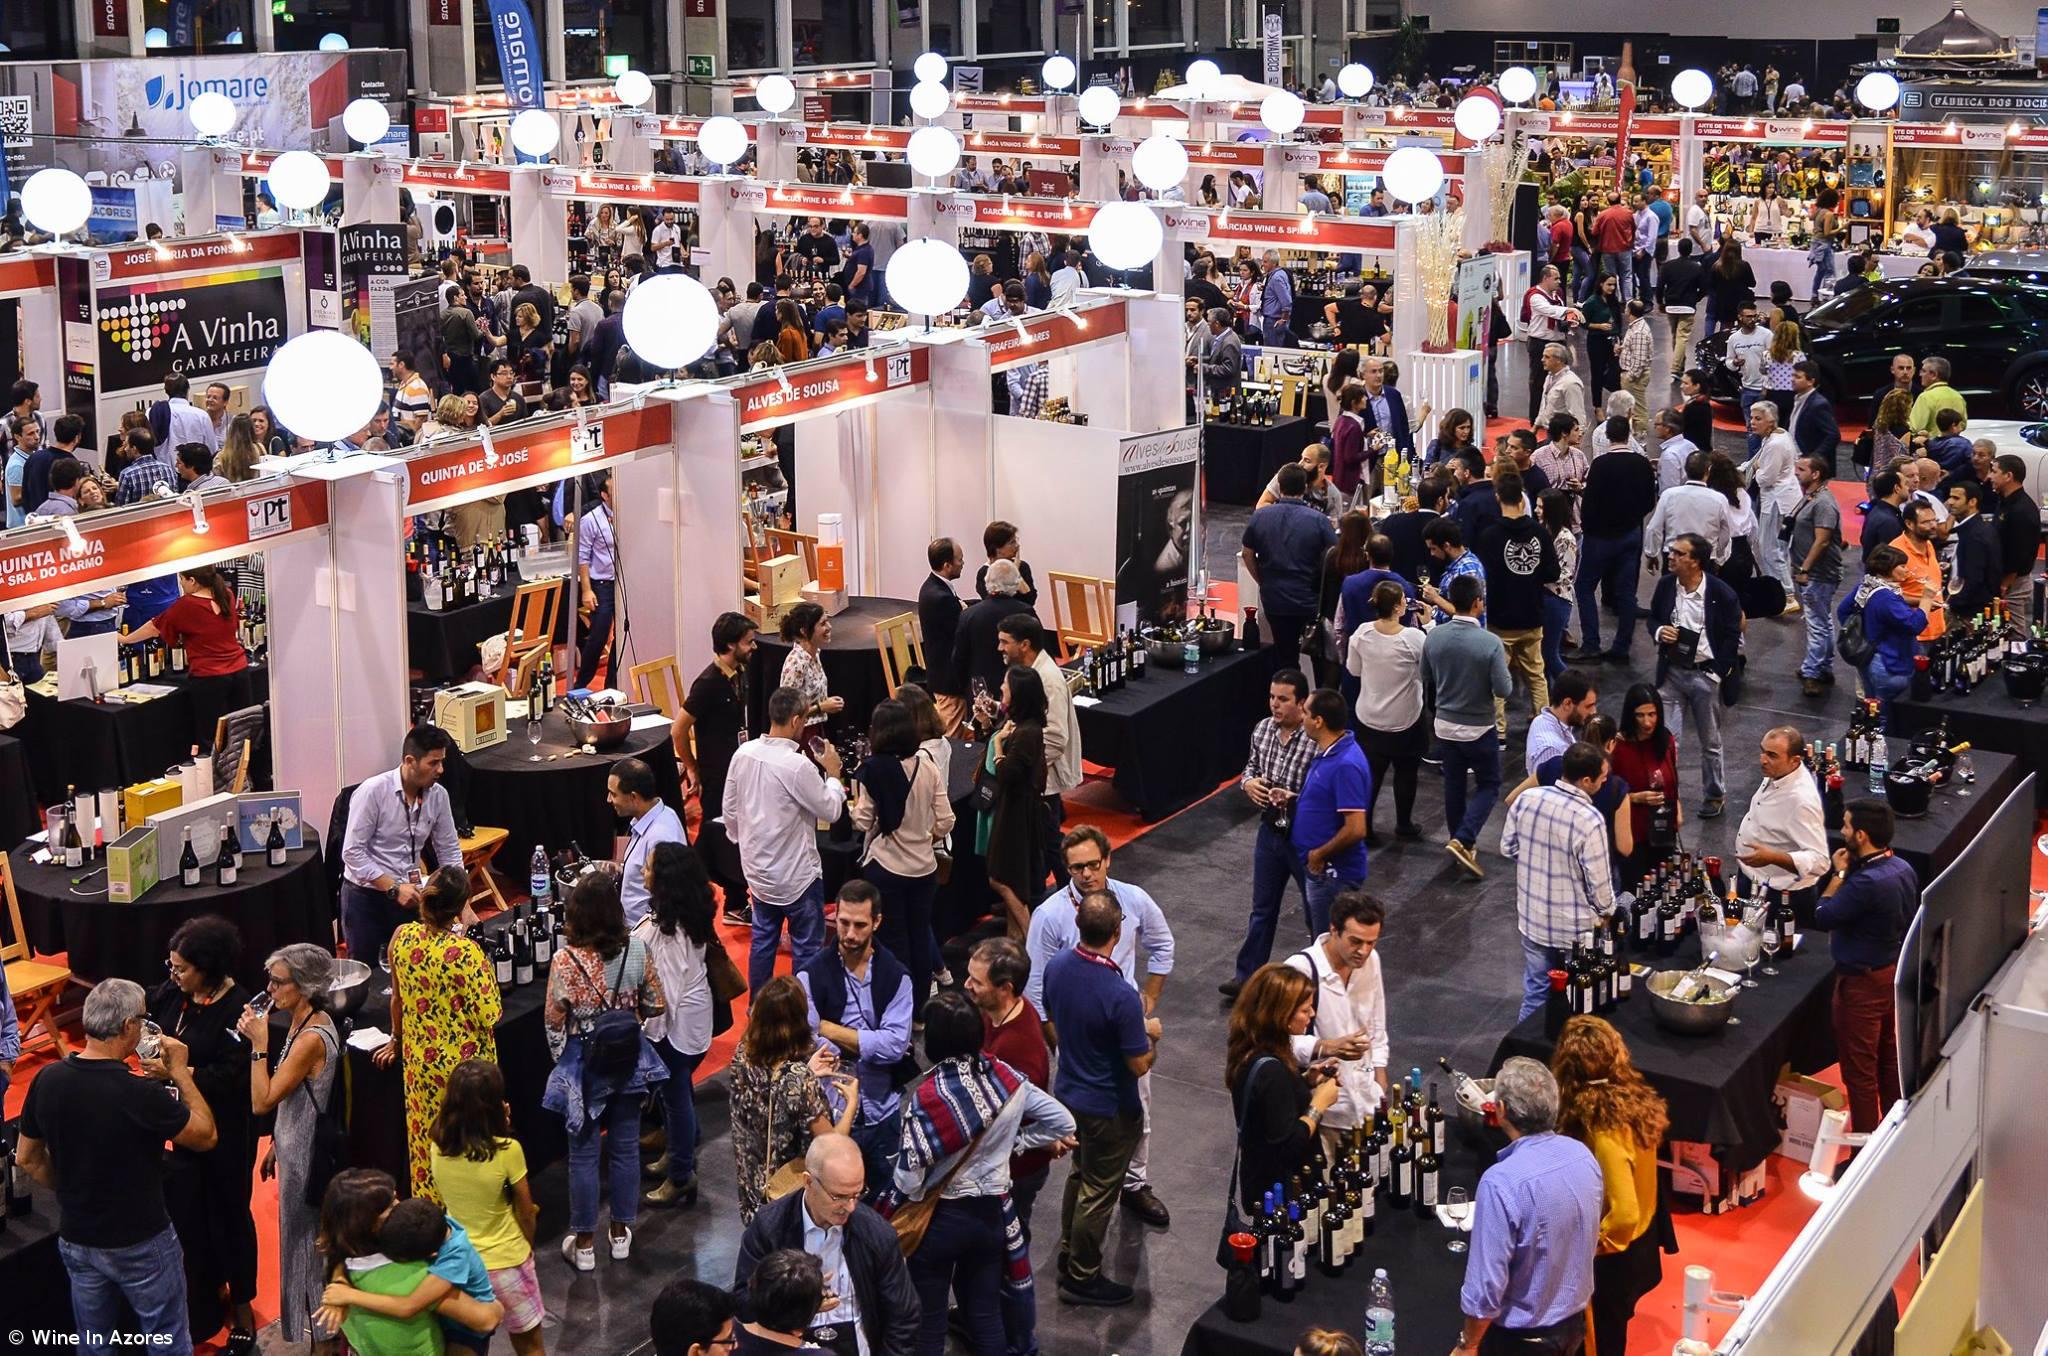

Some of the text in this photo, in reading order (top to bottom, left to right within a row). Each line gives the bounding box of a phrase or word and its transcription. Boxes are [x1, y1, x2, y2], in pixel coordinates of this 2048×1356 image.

[176, 73, 268, 110] jomare
[1934, 95, 1984, 107] FÁBRICA
[1989, 98, 2011, 107] DOS
[862, 134, 890, 142] RTUGAL
[1030, 142, 1062, 150] RTUGAL
[408, 170, 432, 179] RCIAS
[607, 183, 624, 191] WINE
[802, 197, 820, 205] WINE
[828, 197, 854, 206] SPITS
[92, 206, 132, 218] AÇORES
[983, 207, 1015, 217] GARCAS
[1043, 210, 1073, 220] SPIRI
[1254, 225, 1277, 233] WINE
[1278, 225, 1285, 233] &
[1286, 226, 1319, 236] SPITS
[349, 230, 402, 250] Vinha
[124, 243, 254, 265] JOSÉ MRIA DA FONSA
[171, 311, 280, 353] A Vinha
[747, 391, 784, 413] ALVES
[803, 379, 840, 399] SOUSA
[420, 464, 467, 486] QUINTA
[468, 459, 484, 473] DE
[499, 446, 529, 468] JOSÉ
[8, 571, 37, 587] SRA.
[40, 566, 58, 580] DO
[60, 556, 104, 575] CARMO
